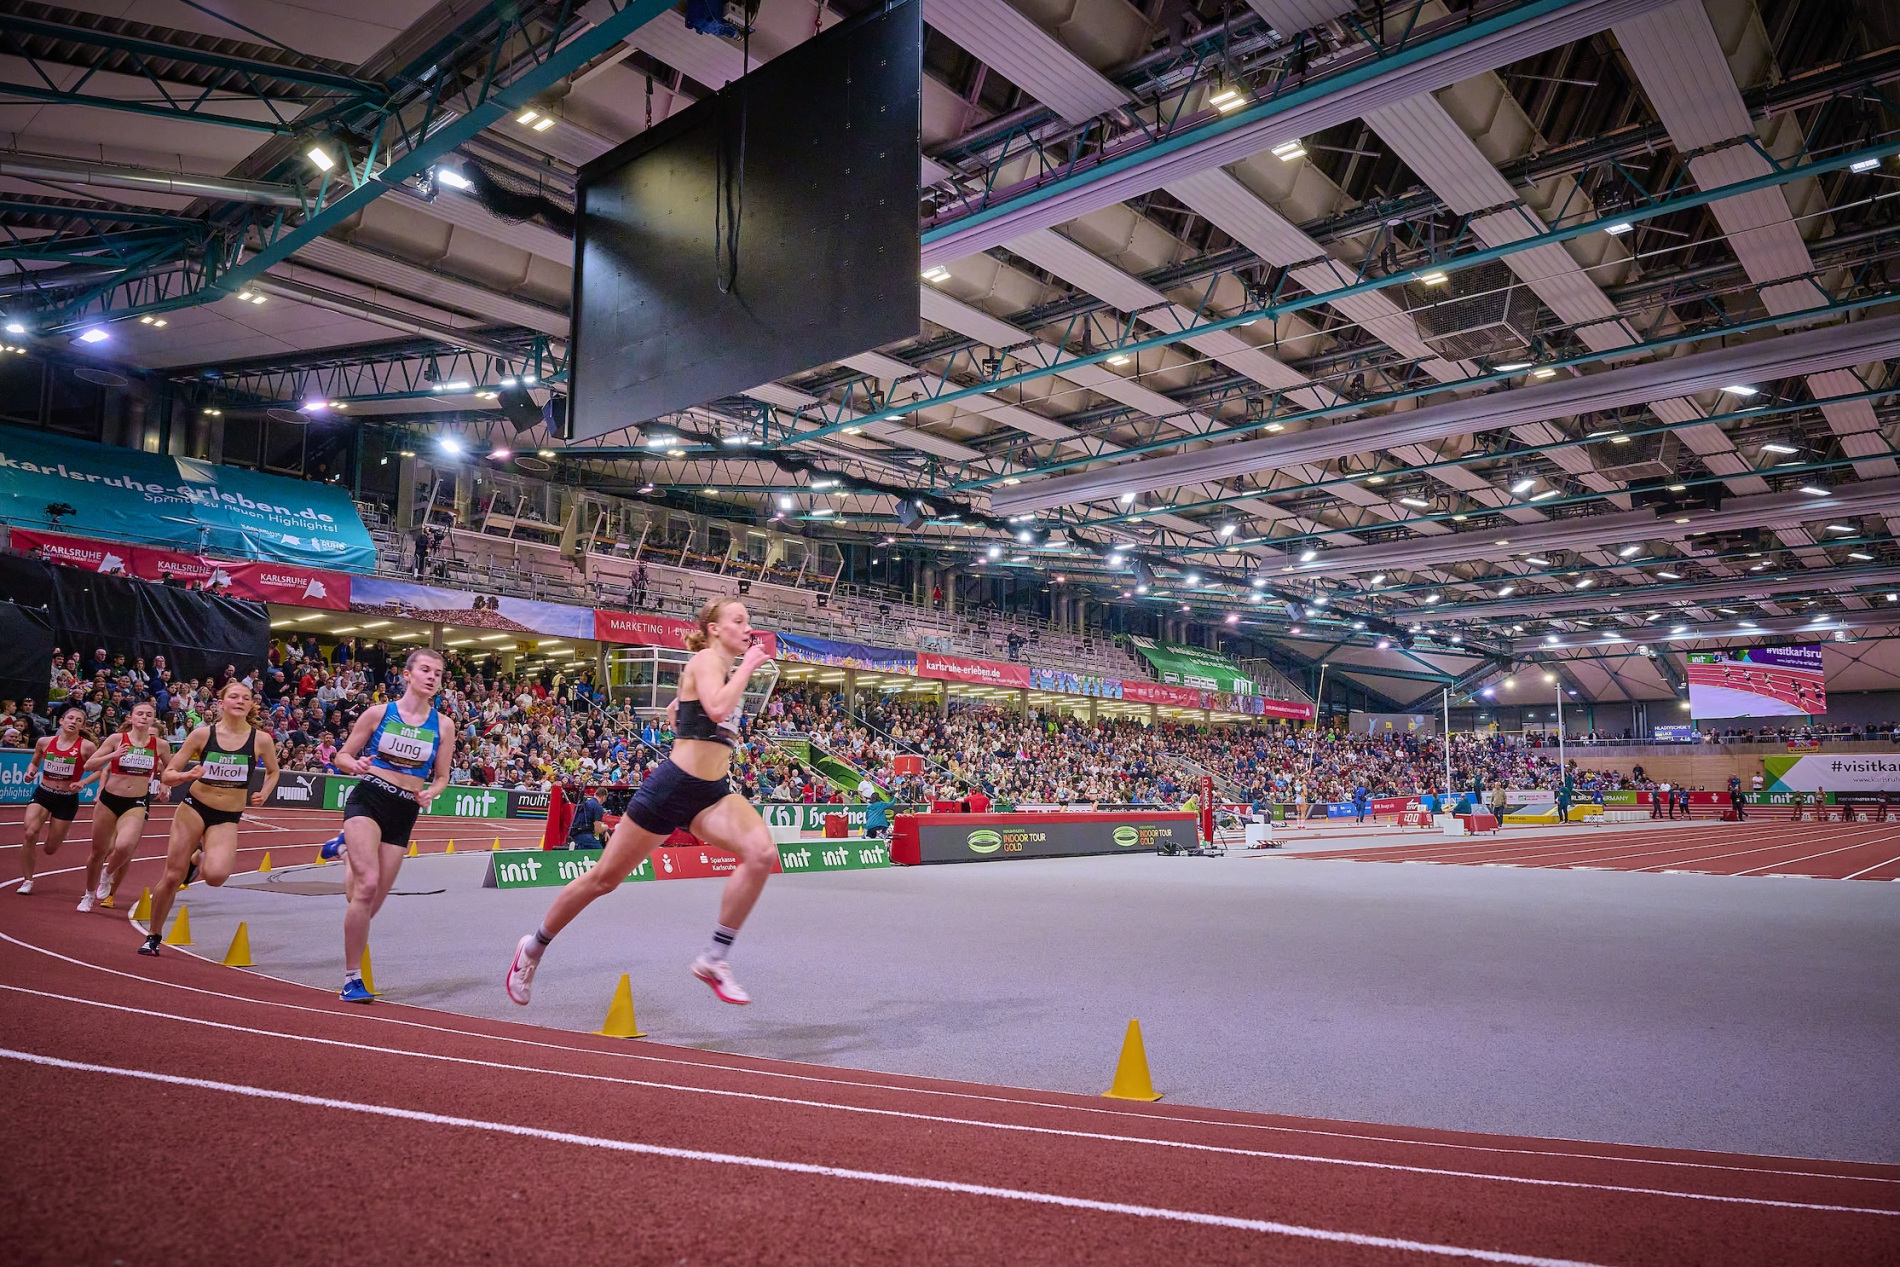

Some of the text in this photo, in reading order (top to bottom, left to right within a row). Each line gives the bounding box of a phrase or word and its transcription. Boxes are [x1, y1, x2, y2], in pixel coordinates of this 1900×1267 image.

[268, 513, 339, 533] Highlights!
[43, 544, 102, 560] KARLSRUHE
[157, 561, 211, 575] KARLSRUHE
[260, 573, 307, 586] KARLSRUHE
[610, 619, 663, 634] MARKETING
[926, 659, 1001, 678] karlsruhe-erleben.de
[401, 727, 421, 739] init
[388, 738, 421, 759] Jung
[121, 755, 152, 767] Rohrbach
[219, 755, 237, 764] init
[46, 762, 71, 773] Brand
[208, 765, 241, 777] Micol
[370, 777, 398, 794] PRO
[399, 790, 417, 801] NIK
[455, 790, 497, 817] init
[1769, 792, 1794, 804] init
[1003, 833, 1047, 843] INDOOR TOUR
[1139, 829, 1173, 838] INDOOR TOUR
[1004, 843, 1023, 852] GOLD
[1140, 837, 1155, 845] GOLD
[710, 856, 736, 864] Sparkasse
[782, 847, 812, 868] init
[821, 846, 850, 866] init
[858, 845, 885, 865] init
[500, 857, 542, 883] init
